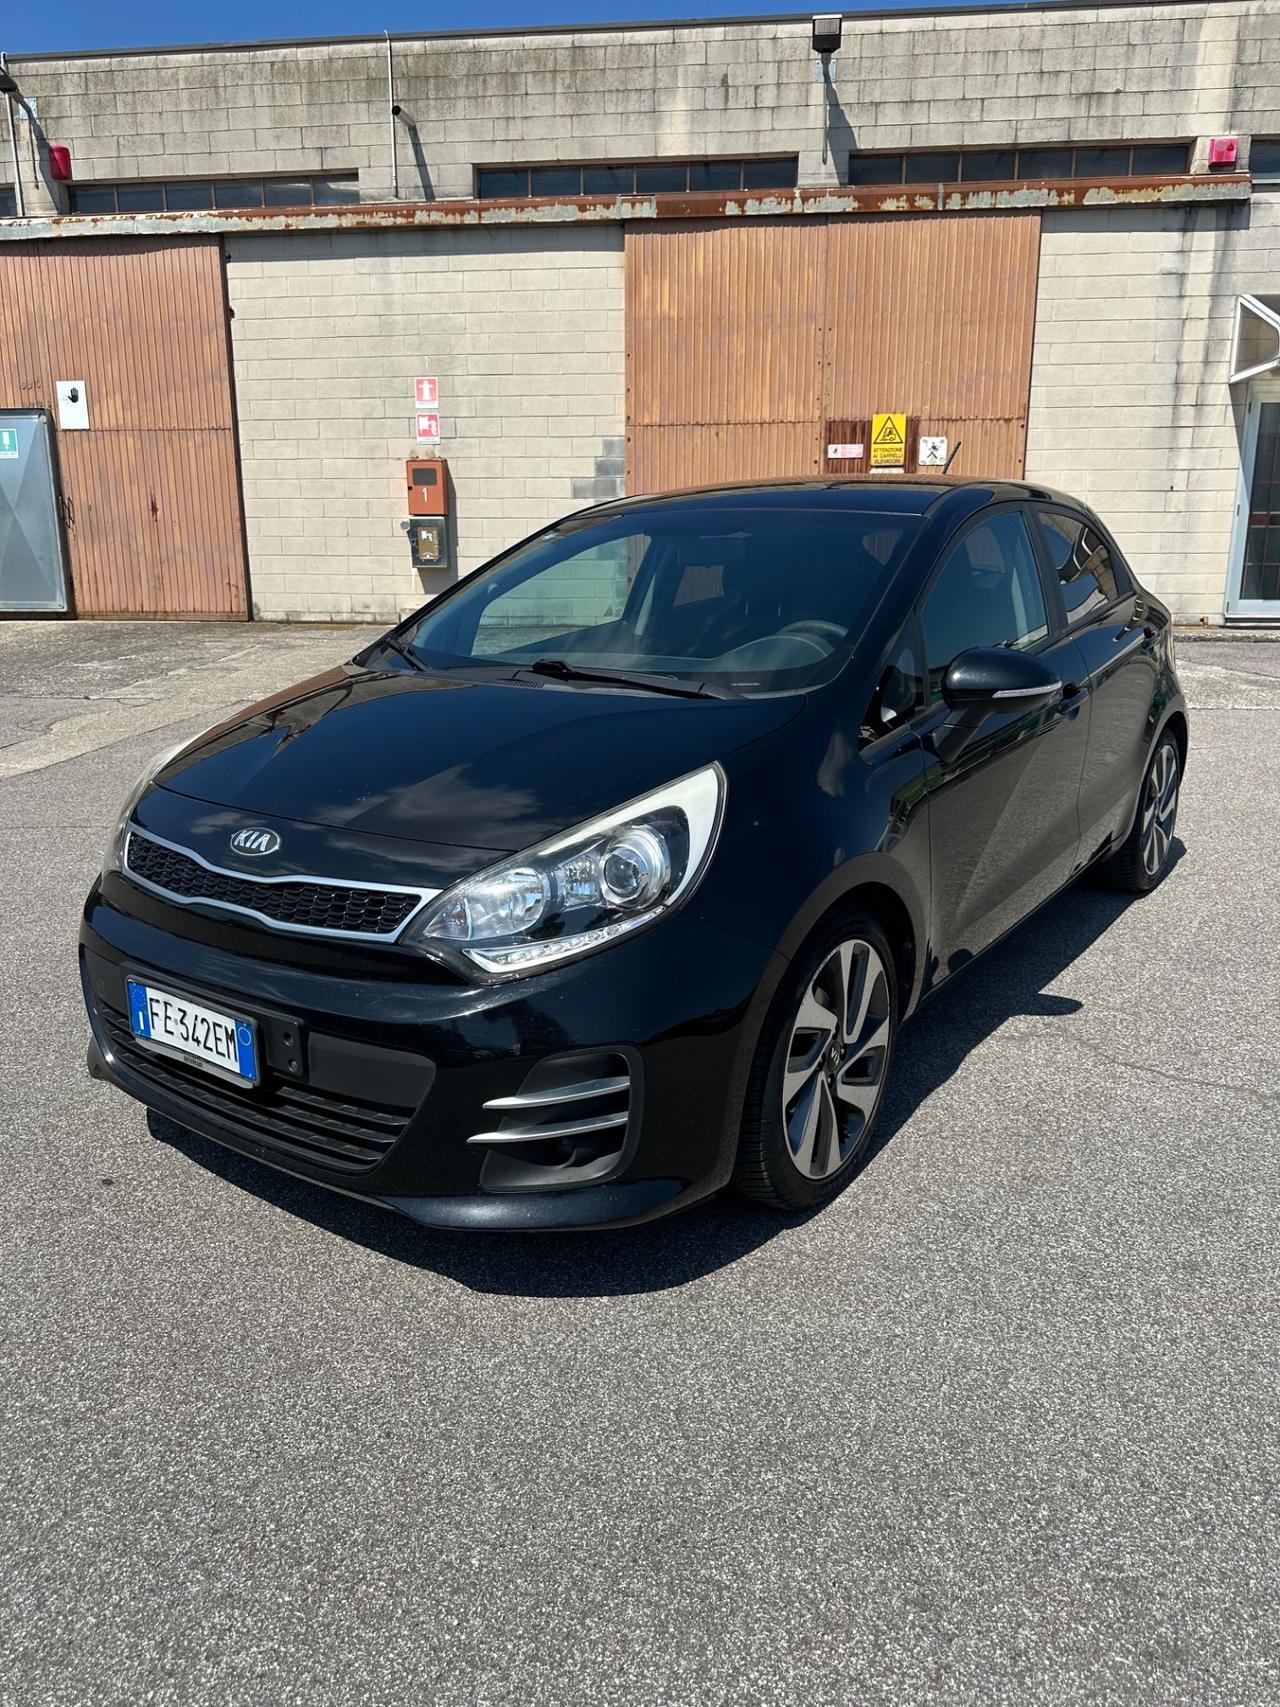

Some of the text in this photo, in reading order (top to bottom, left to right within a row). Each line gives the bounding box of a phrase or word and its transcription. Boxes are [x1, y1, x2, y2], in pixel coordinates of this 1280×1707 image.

[422, 487, 428, 503] 1
[233, 830, 271, 851] KIA
[148, 997, 239, 1063] FE342EM
